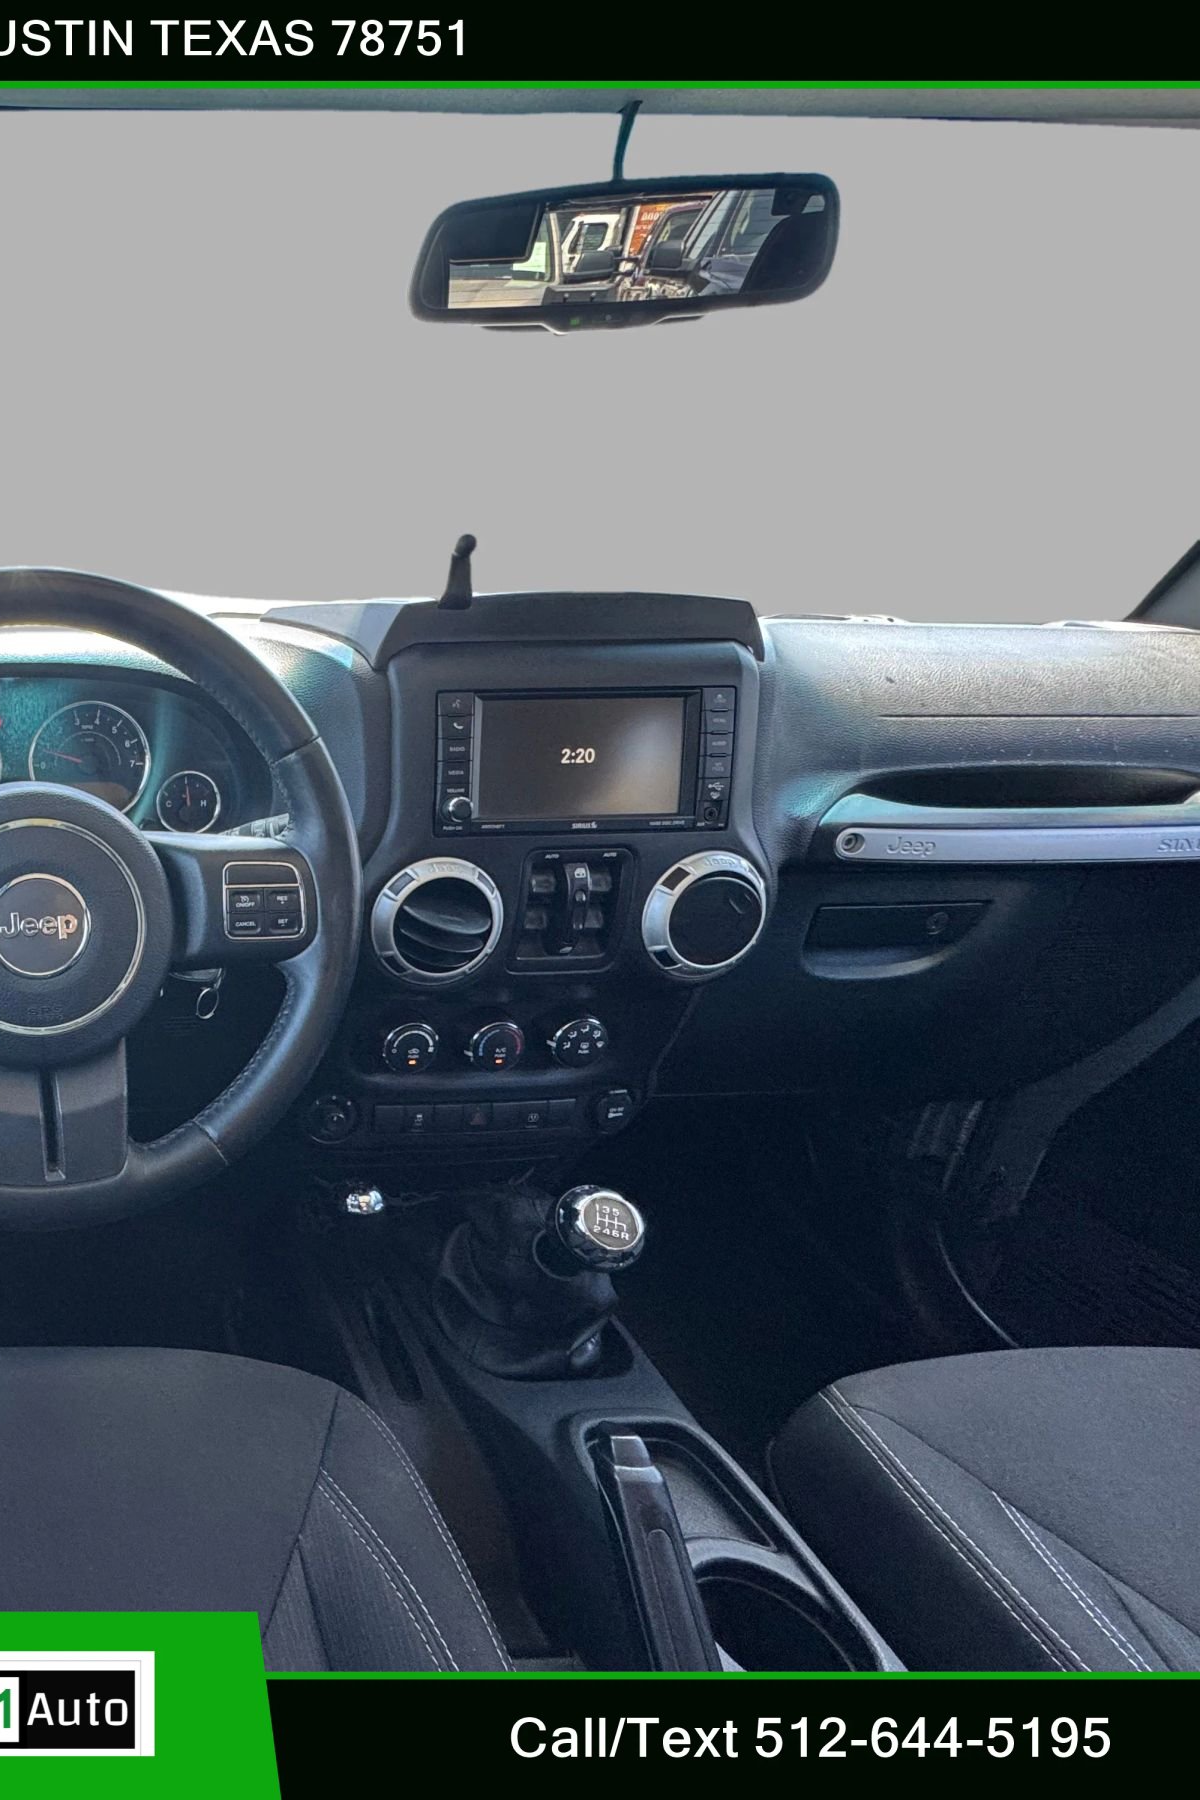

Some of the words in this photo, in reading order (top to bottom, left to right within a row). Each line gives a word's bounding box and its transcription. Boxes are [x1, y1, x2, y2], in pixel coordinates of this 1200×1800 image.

[111, 726, 118, 734] 5
[560, 747, 596, 764] 2:20
[129, 760, 136, 768] 7
[165, 800, 172, 808] C
[887, 836, 936, 857] Jeep
